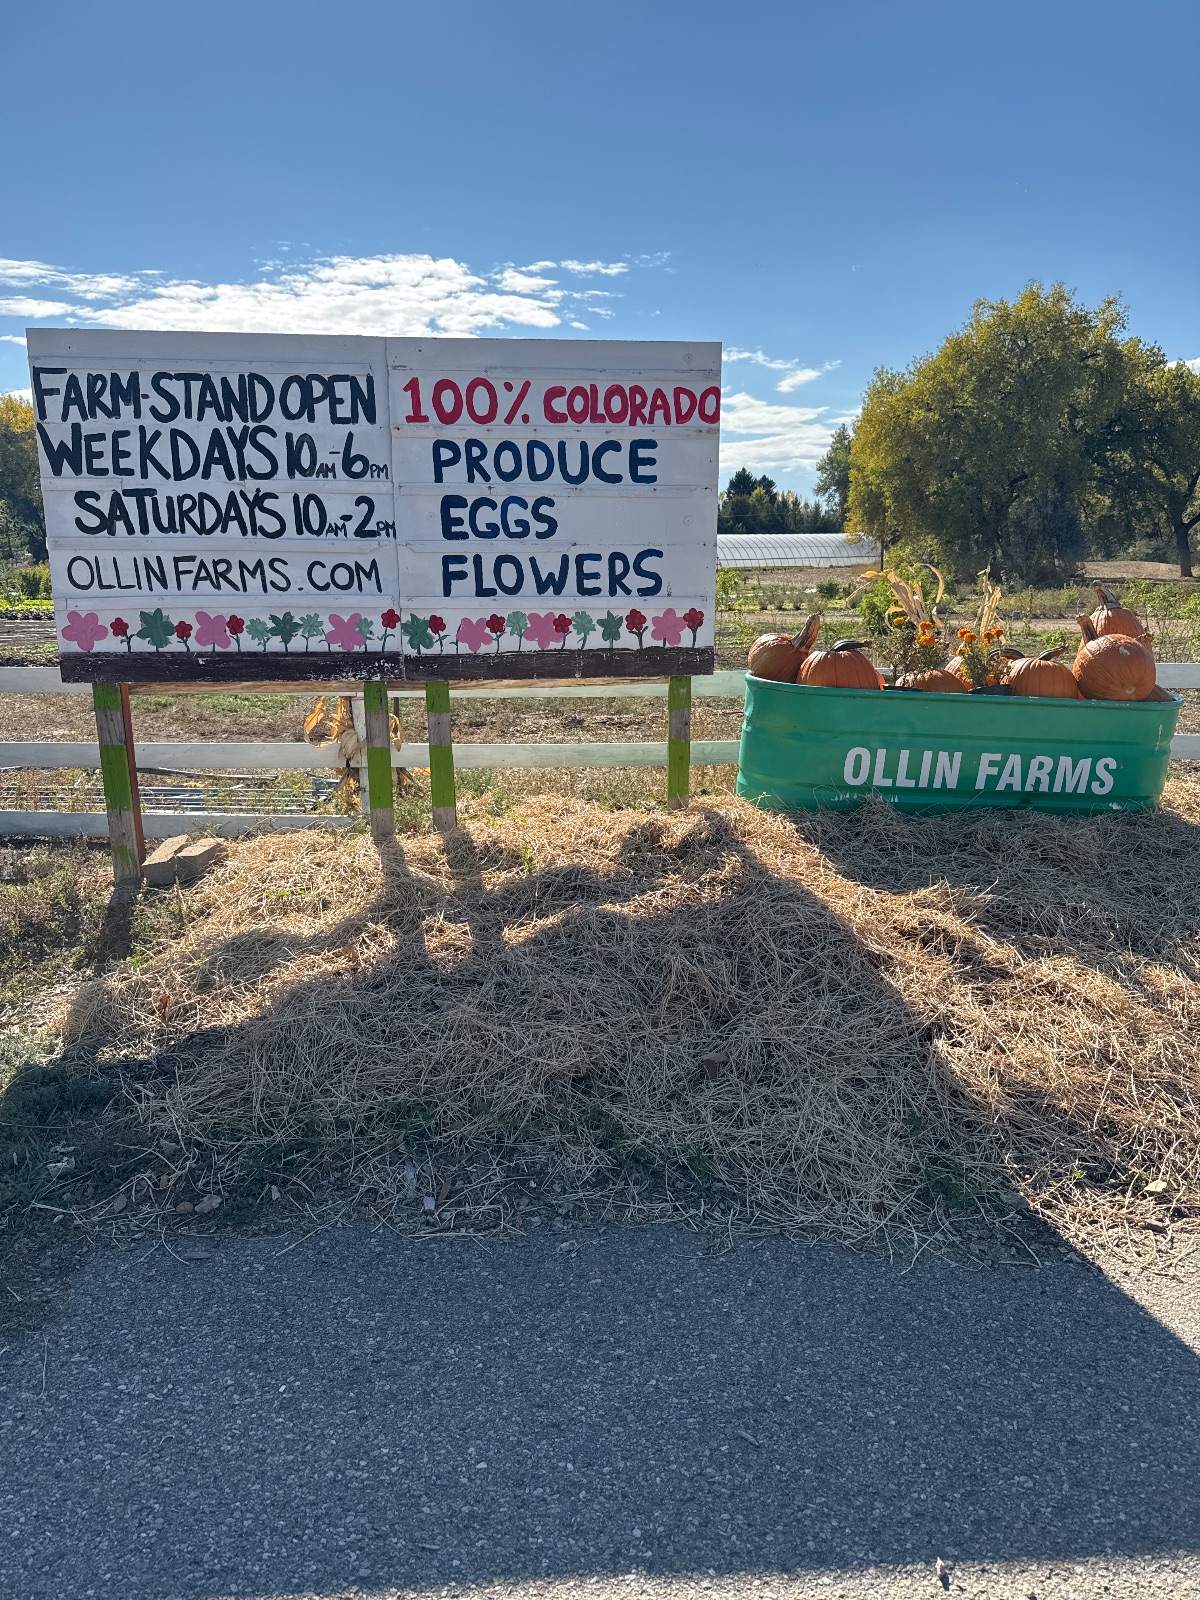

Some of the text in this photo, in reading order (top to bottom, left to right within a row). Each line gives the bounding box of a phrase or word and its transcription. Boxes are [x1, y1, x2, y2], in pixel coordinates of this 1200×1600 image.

[279, 373, 376, 425] OPEN
[403, 377, 721, 426] 100% COLORADO
[37, 422, 279, 481] WEEKDAYS
[432, 438, 658, 484] PRODUCE
[74, 488, 287, 539] SATURDAYS
[440, 495, 558, 540] EGGS
[442, 549, 664, 597] FLOWERS
[843, 746, 1116, 795] OLLIN FARMS
